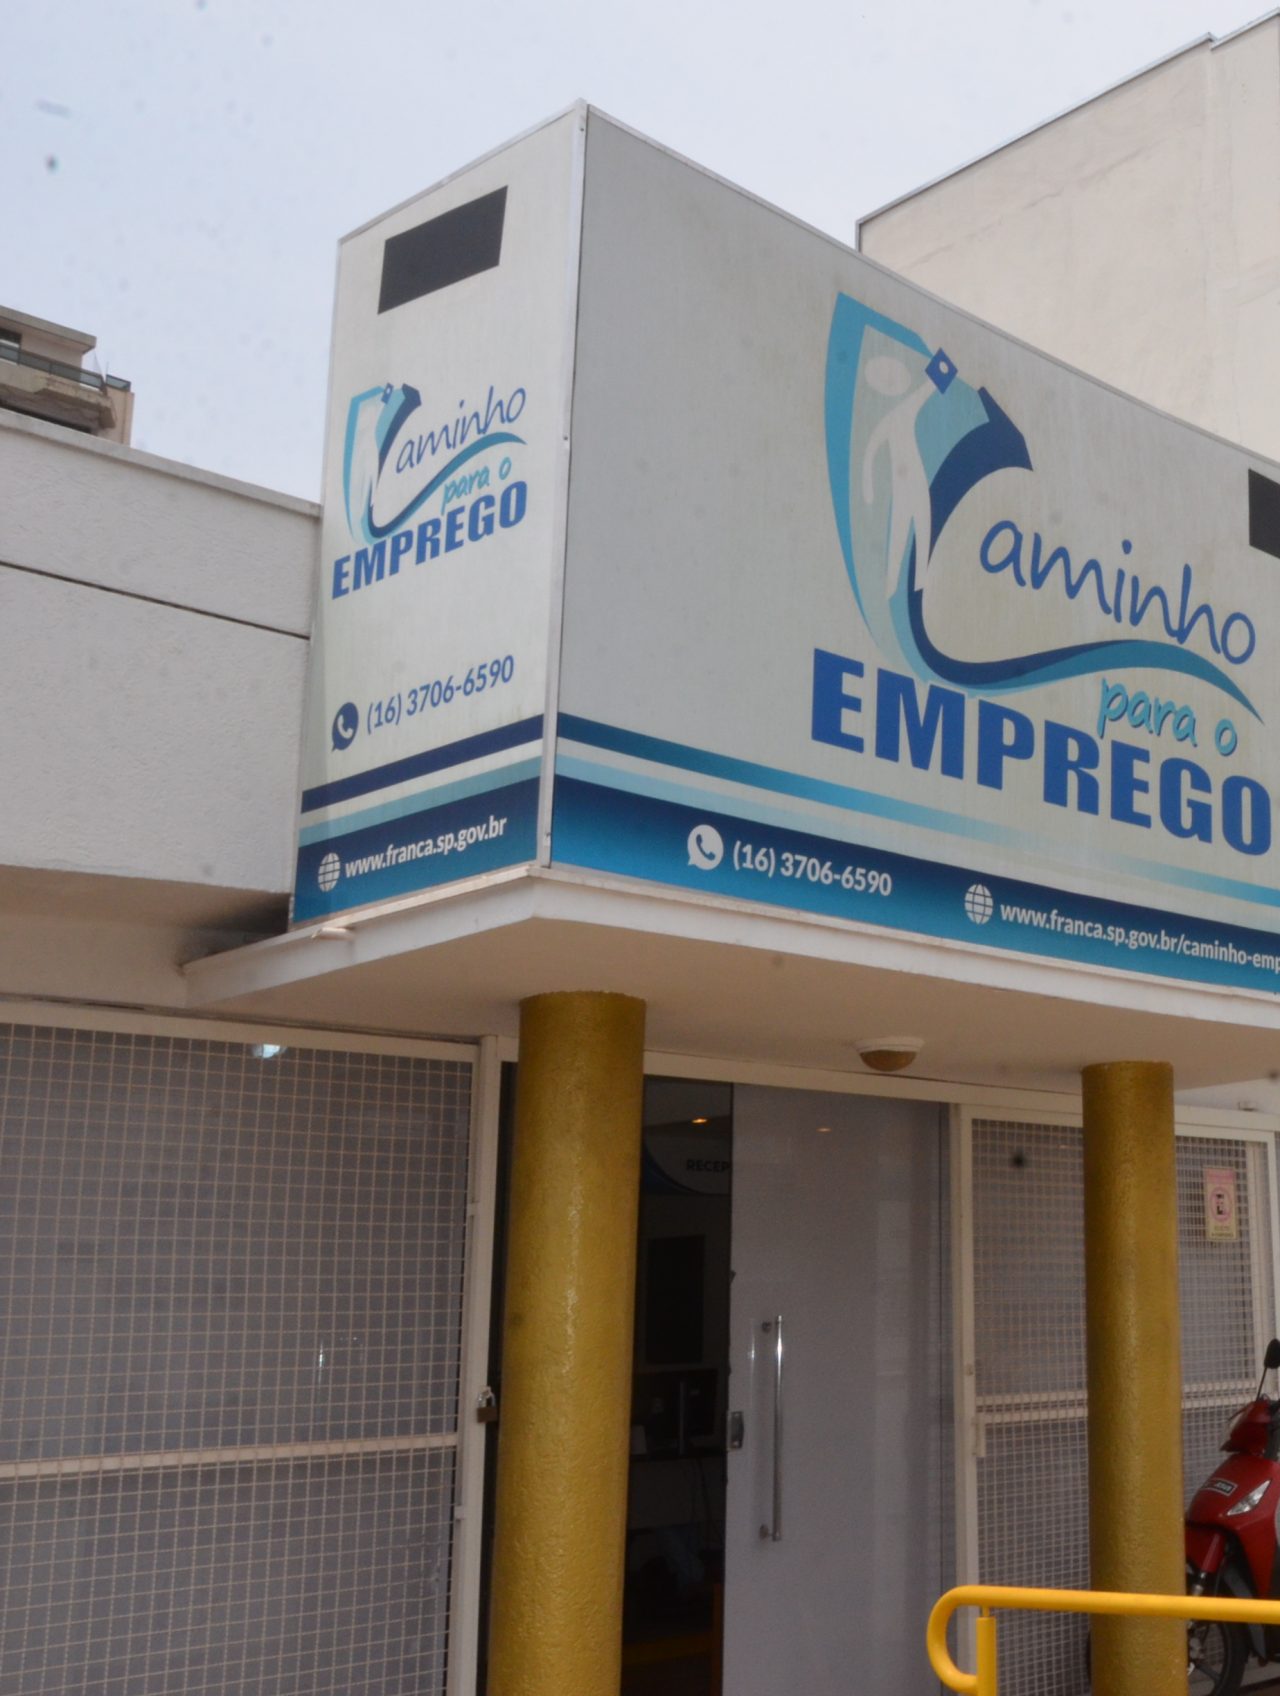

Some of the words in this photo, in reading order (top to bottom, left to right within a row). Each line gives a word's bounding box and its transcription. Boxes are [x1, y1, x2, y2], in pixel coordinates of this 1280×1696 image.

[440, 466, 490, 516] para
[498, 456, 513, 481] o
[331, 480, 528, 600] EMPREGO
[366, 693, 403, 735] (16)
[406, 654, 515, 717] 3706-6590
[1095, 676, 1198, 747] para
[1213, 718, 1239, 757] o
[810, 646, 1273, 857] EMPREGO
[344, 815, 508, 879] www.franca.sp.gov.br
[732, 840, 777, 878] (16)
[780, 851, 893, 897] 3706-6590
